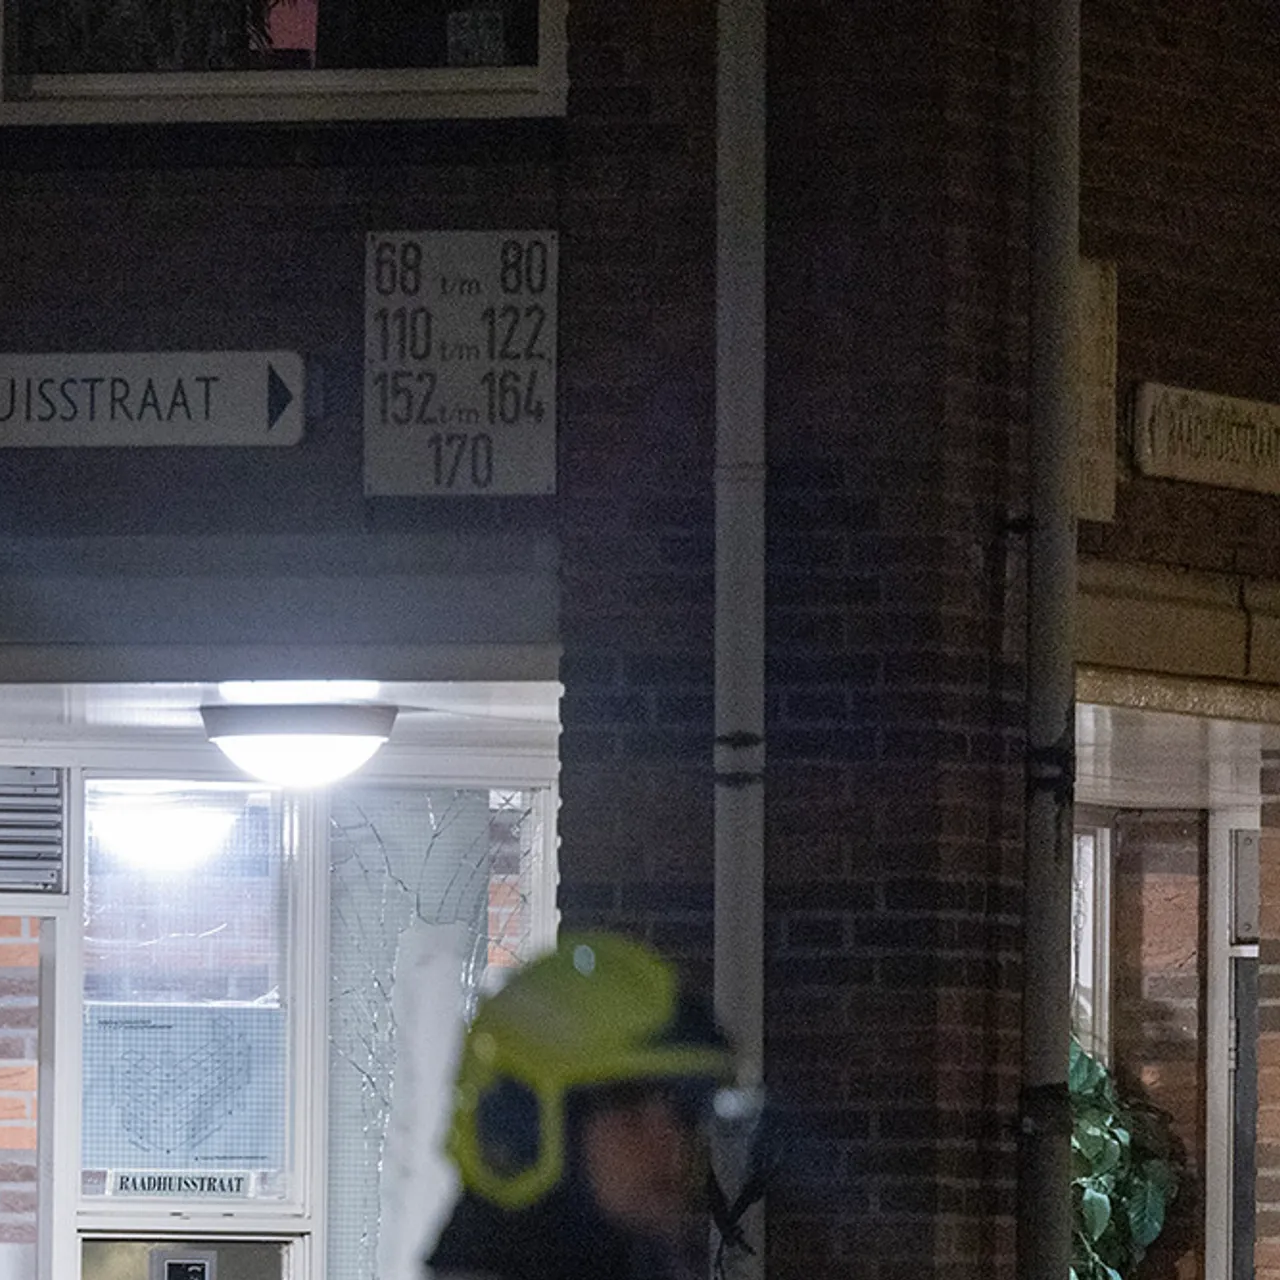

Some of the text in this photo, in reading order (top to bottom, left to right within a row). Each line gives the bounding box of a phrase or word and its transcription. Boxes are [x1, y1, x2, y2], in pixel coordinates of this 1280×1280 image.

[374, 240, 548, 295] 68 t/m 80
[374, 305, 547, 361] 110 t/m 122
[373, 369, 546, 425] 152 t/m 164
[428, 432, 494, 488] 170
[118, 1175, 245, 1193] RAADHUISSTRAAT
